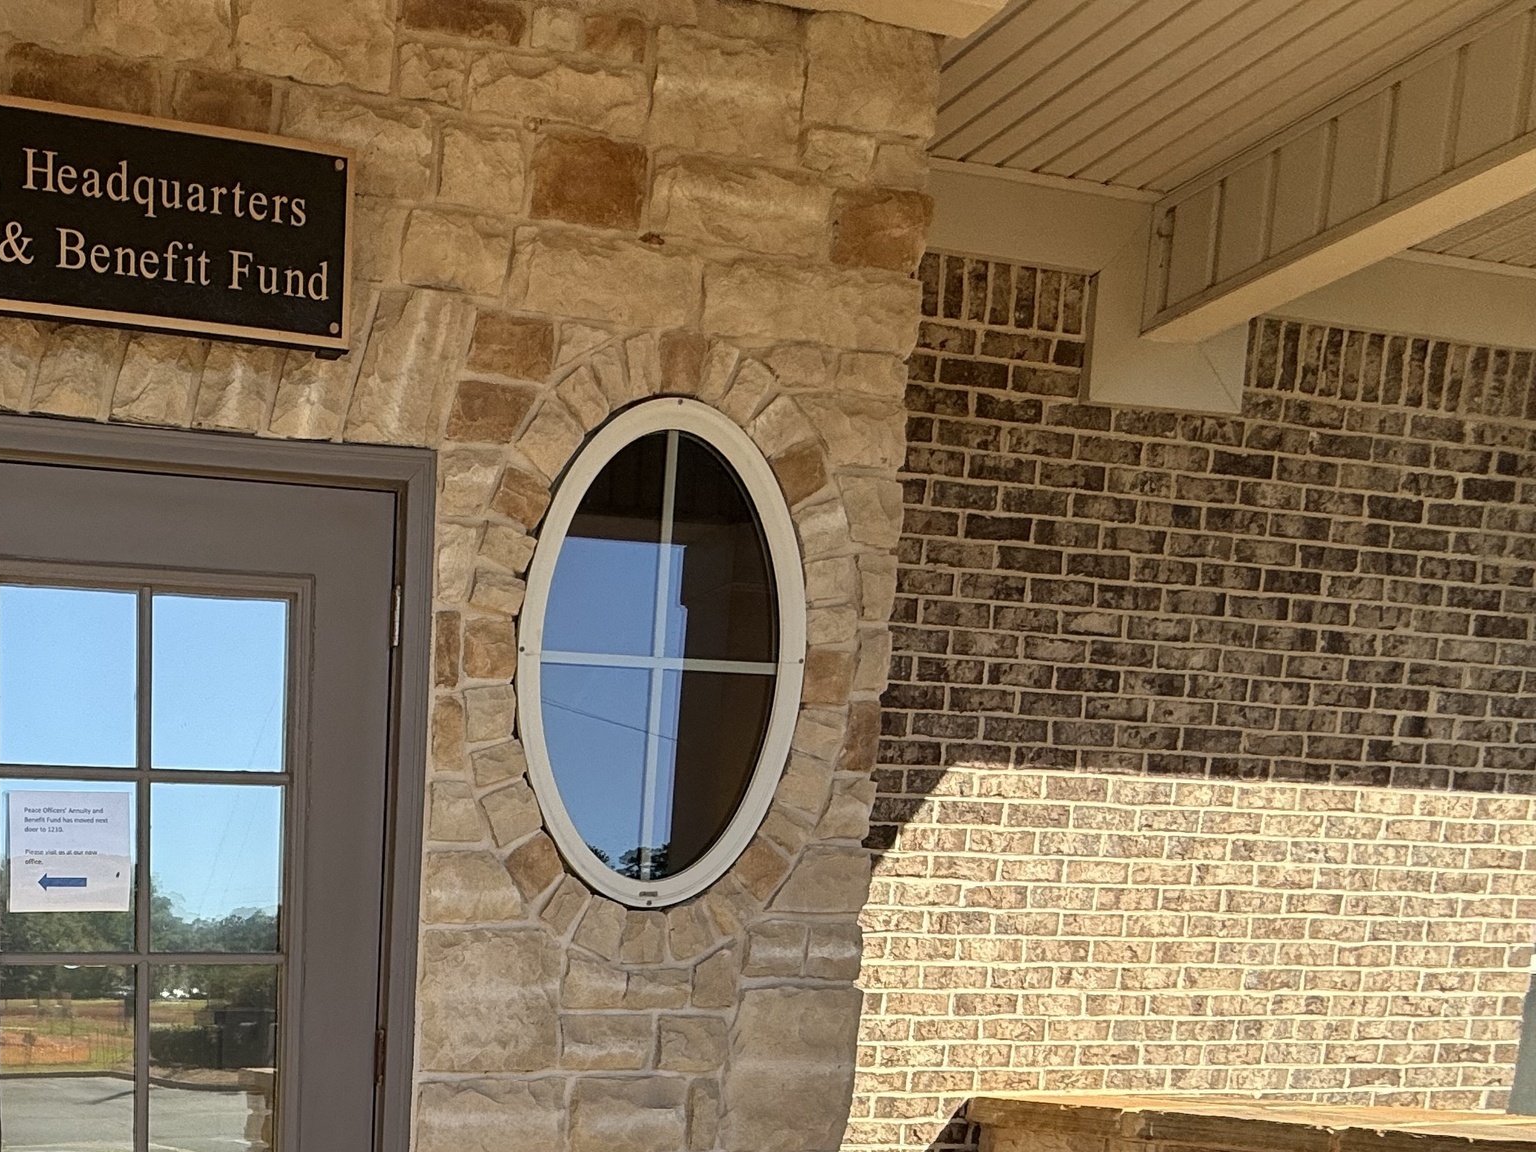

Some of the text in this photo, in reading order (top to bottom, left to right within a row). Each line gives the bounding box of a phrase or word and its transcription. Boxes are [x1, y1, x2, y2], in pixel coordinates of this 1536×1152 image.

[22, 147, 308, 227] Headquarters
[56, 227, 212, 286] Benefit
[228, 250, 331, 302] Fund
